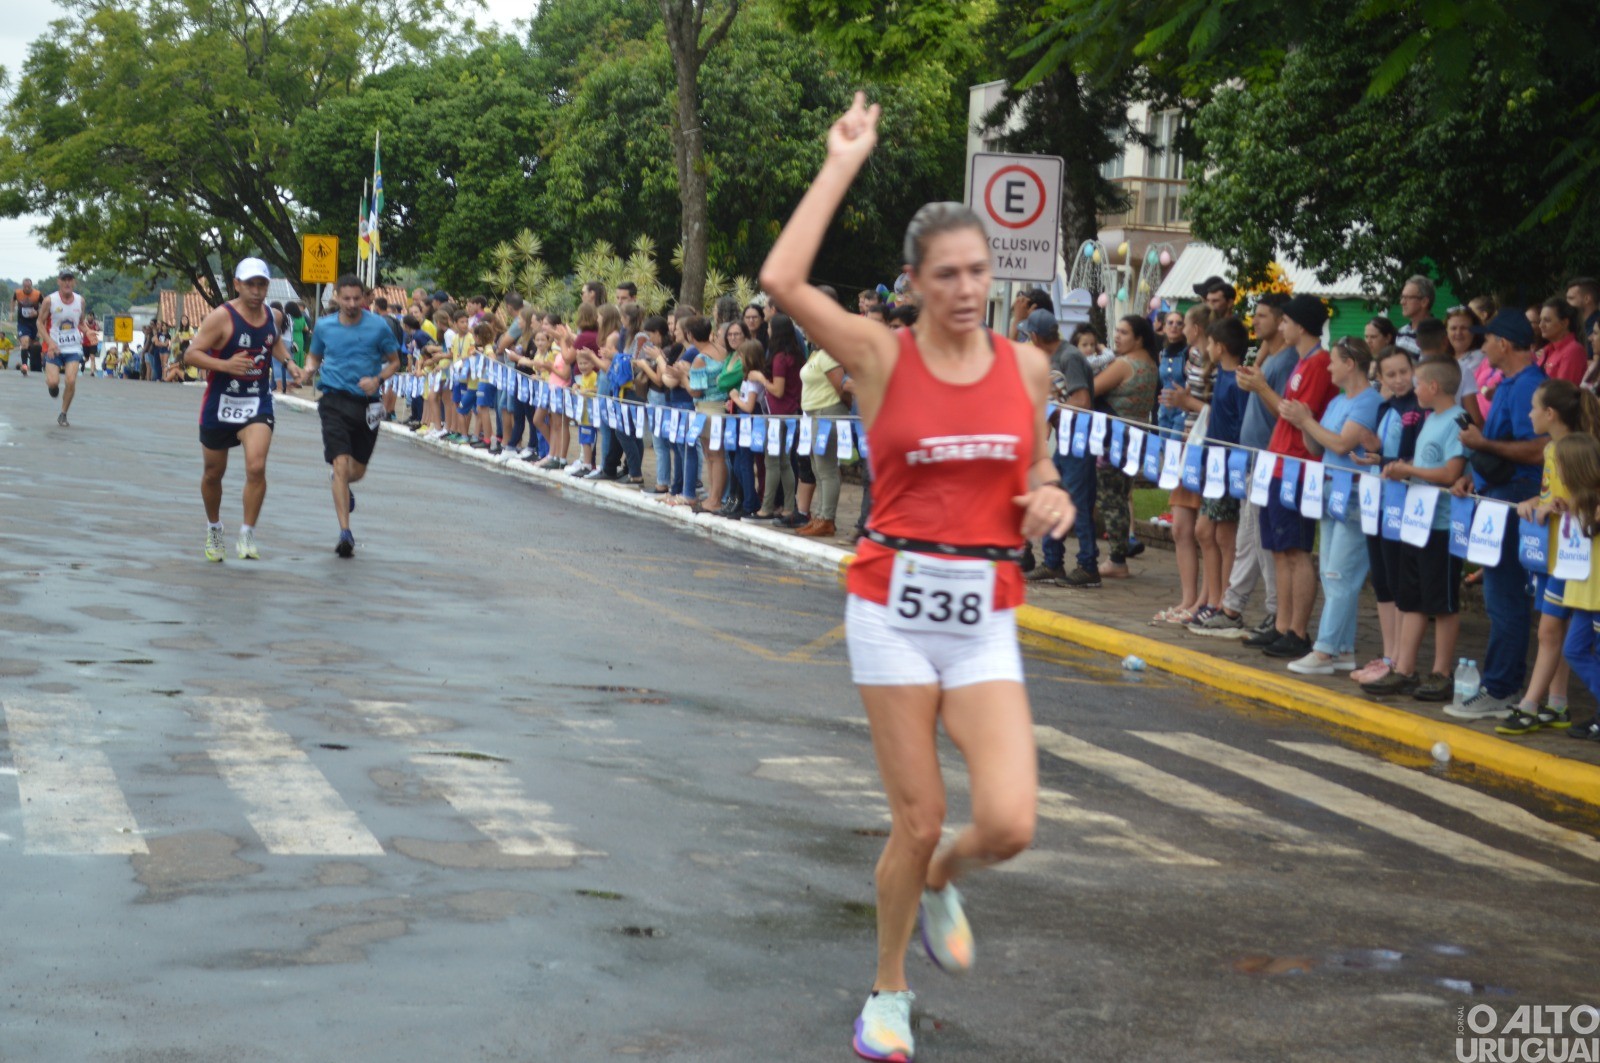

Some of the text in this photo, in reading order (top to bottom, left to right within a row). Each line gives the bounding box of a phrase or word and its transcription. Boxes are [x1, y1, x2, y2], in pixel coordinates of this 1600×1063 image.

[1005, 180, 1026, 213] E
[986, 236, 1050, 252] XCLUSIVO
[997, 252, 1027, 269] TÁXI
[221, 406, 254, 420] 662
[1403, 514, 1430, 529] Banrisul
[1470, 533, 1500, 548] Banrisul
[1558, 549, 1589, 561] Banrisul
[897, 585, 983, 625] 538
